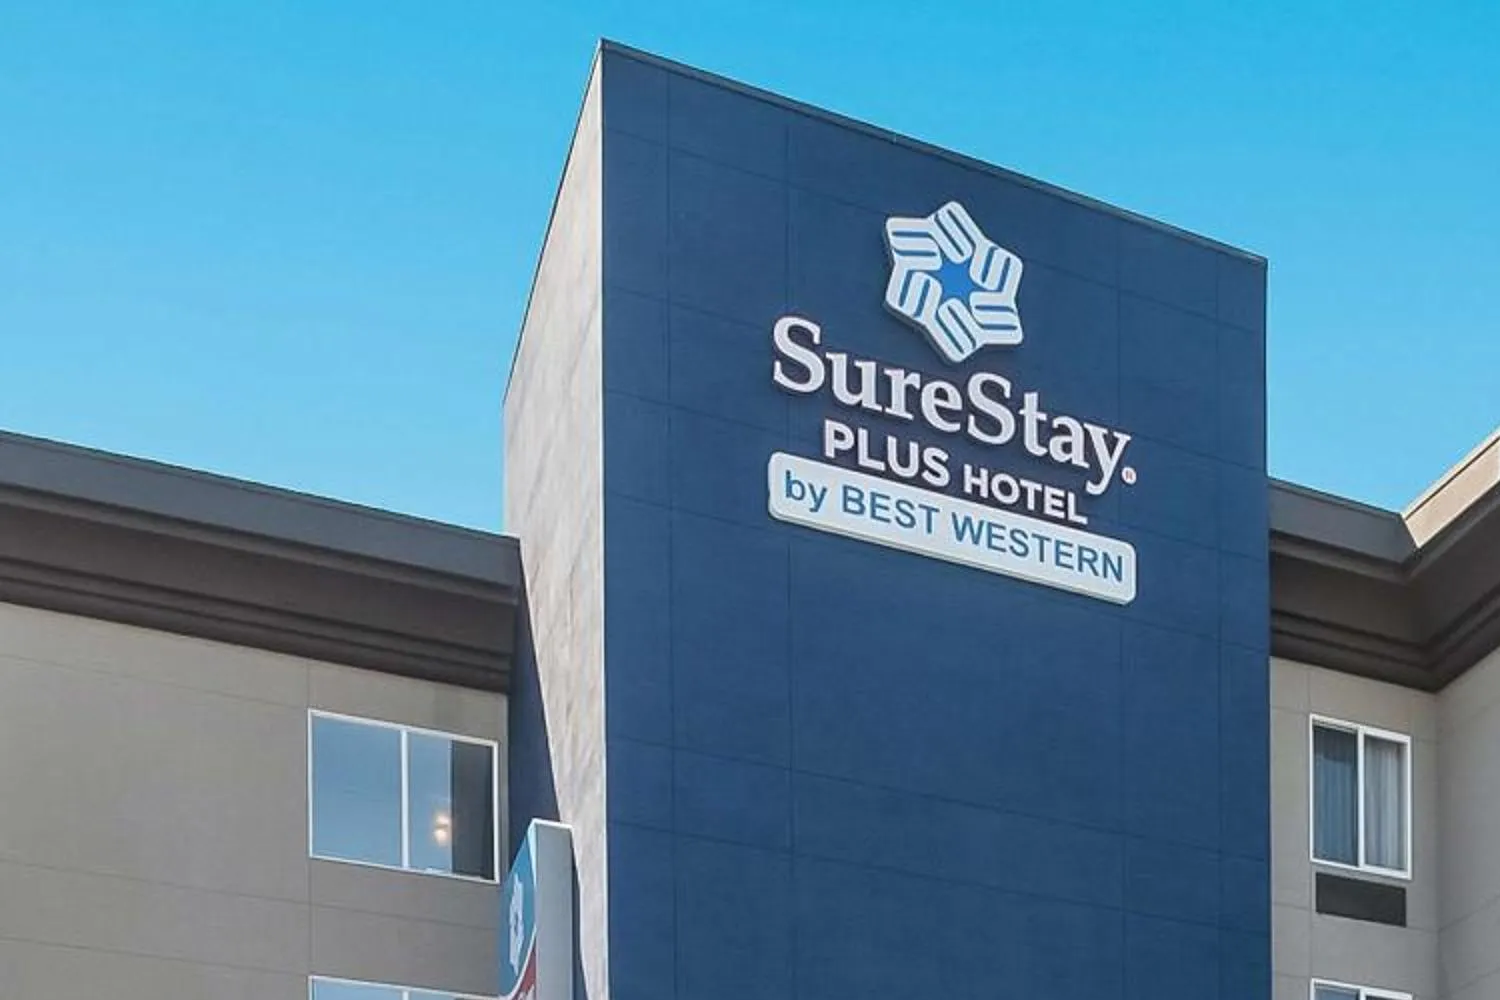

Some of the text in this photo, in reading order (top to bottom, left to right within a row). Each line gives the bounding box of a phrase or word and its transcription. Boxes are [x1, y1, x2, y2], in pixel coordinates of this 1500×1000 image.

[773, 316, 1132, 495] SureStay
[784, 469, 1124, 583] by BEST WESTERN
[824, 419, 1089, 525] PLUS HOTEL
